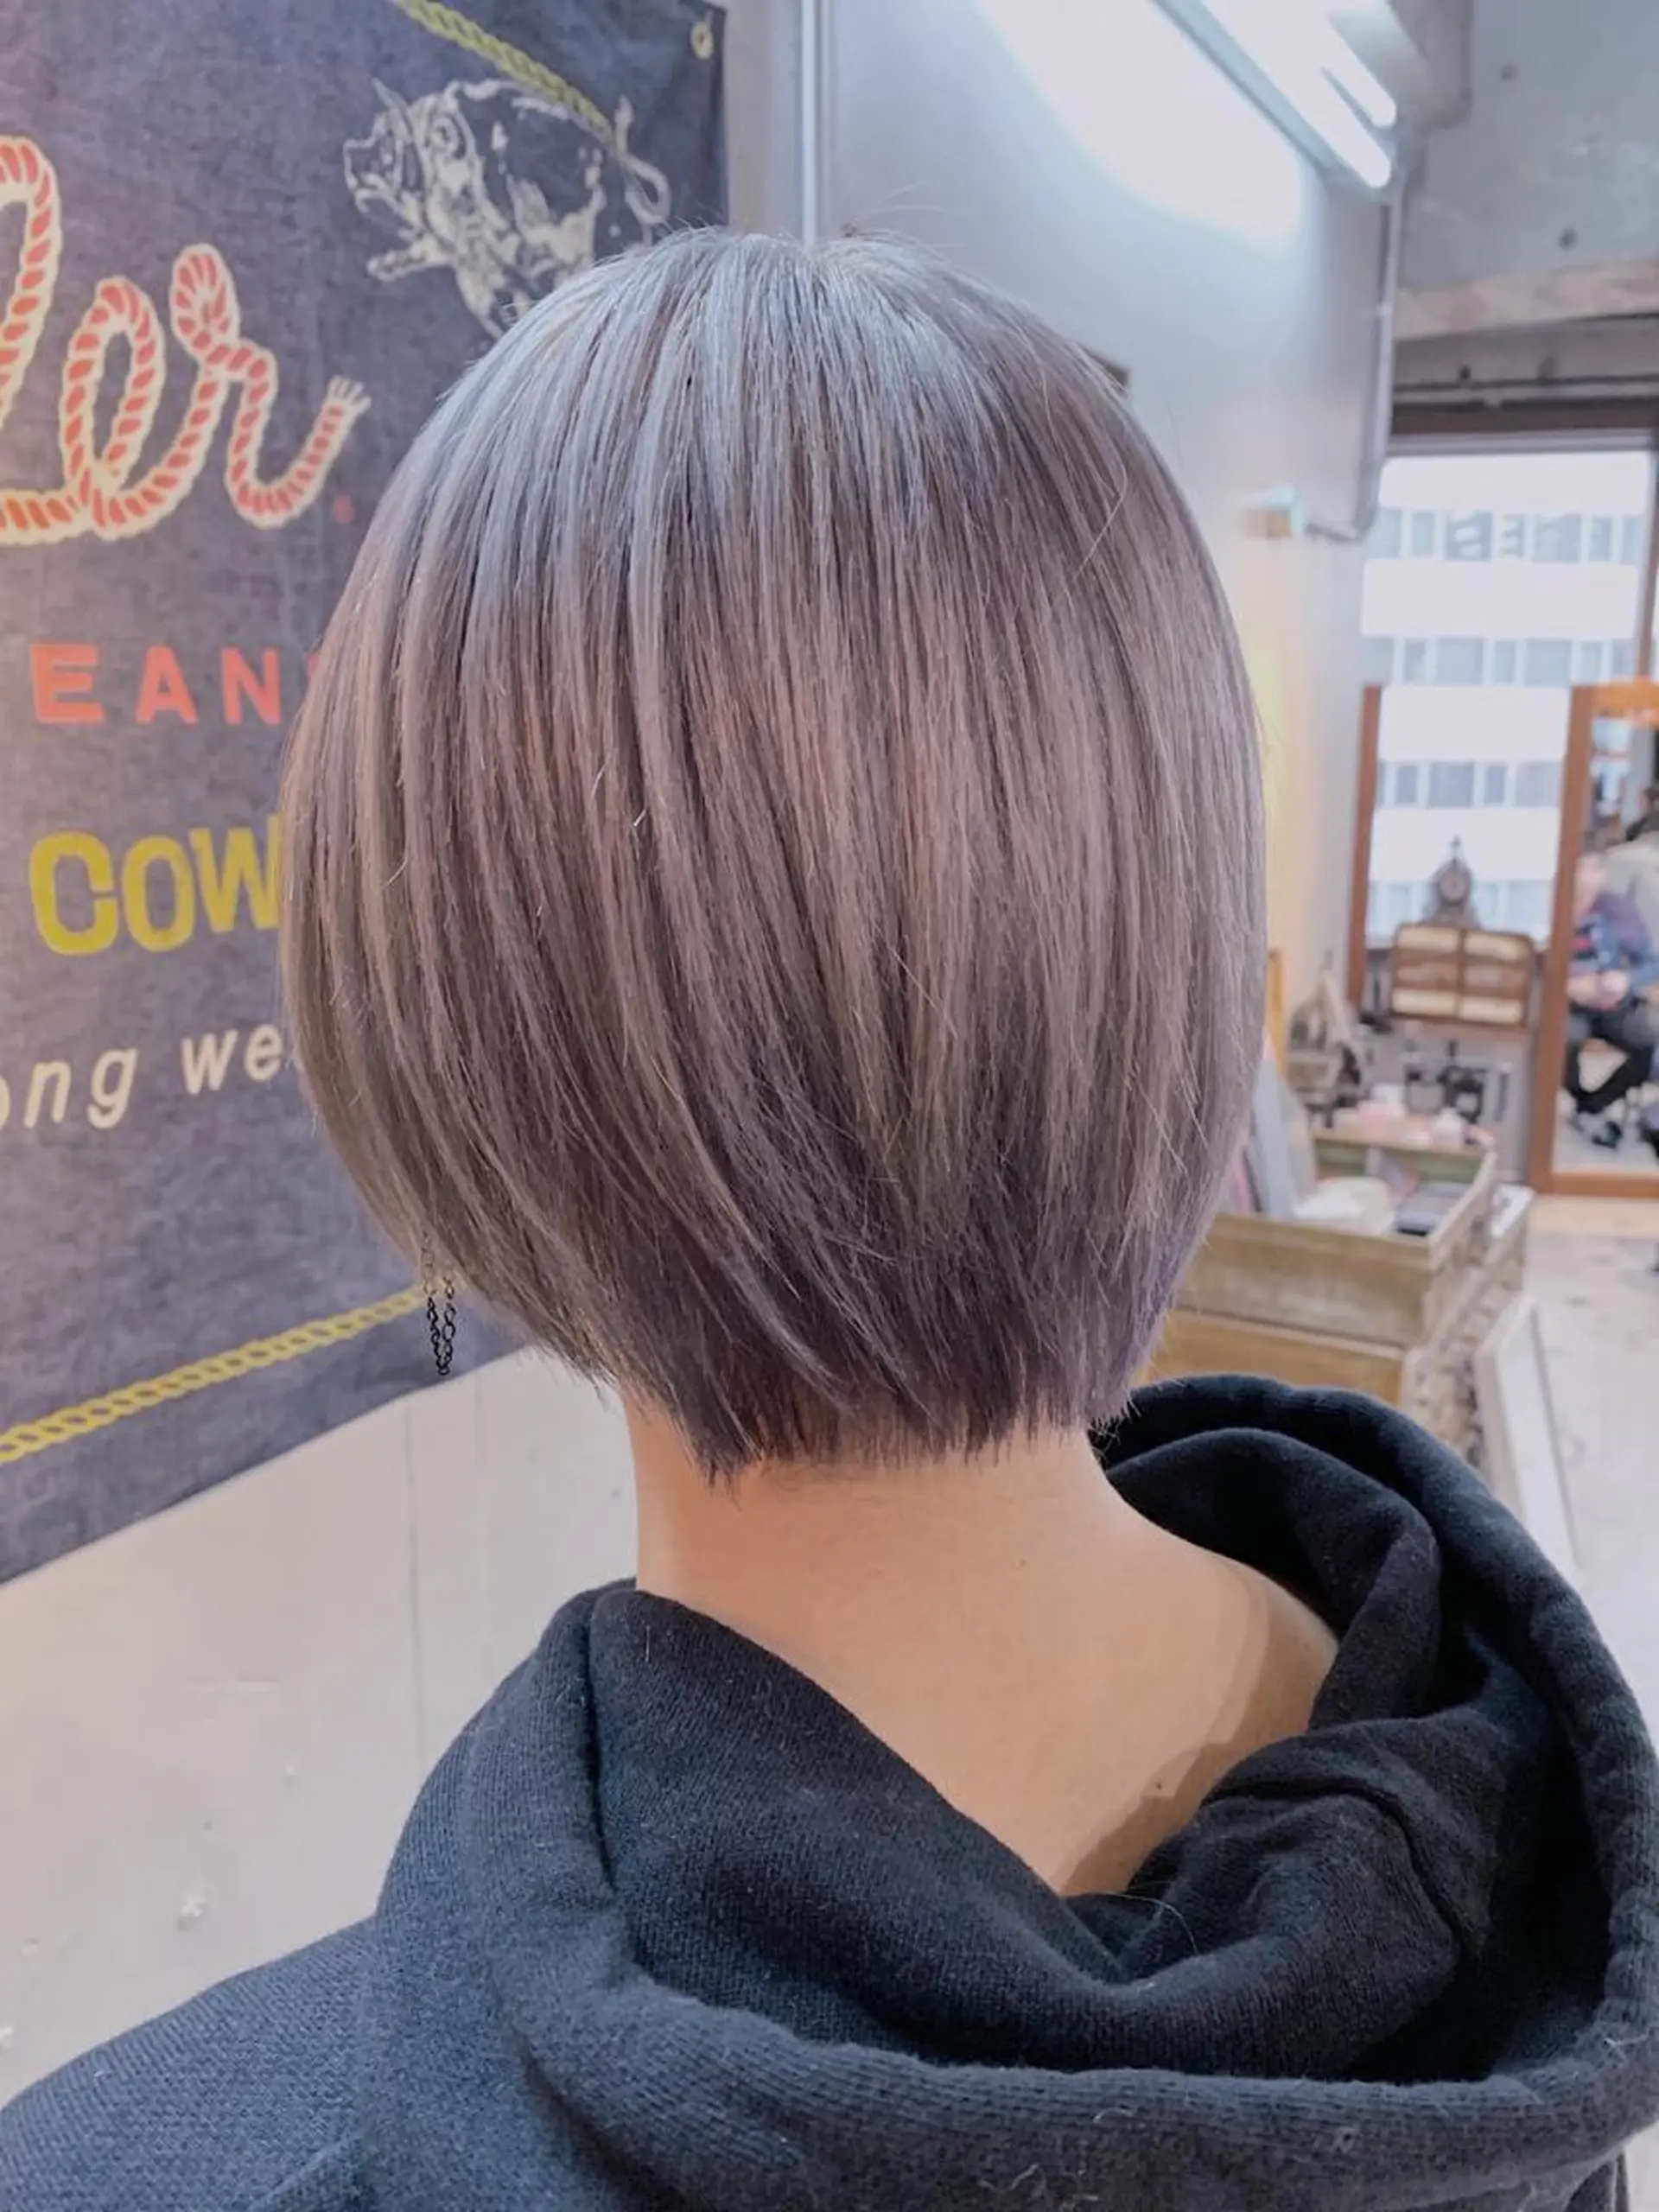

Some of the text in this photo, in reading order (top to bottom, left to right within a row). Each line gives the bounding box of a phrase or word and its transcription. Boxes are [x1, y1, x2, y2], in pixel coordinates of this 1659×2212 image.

[30, 643, 318, 726] EAN
[29, 812, 280, 955] COW
[0, 1024, 302, 1129] ng we
